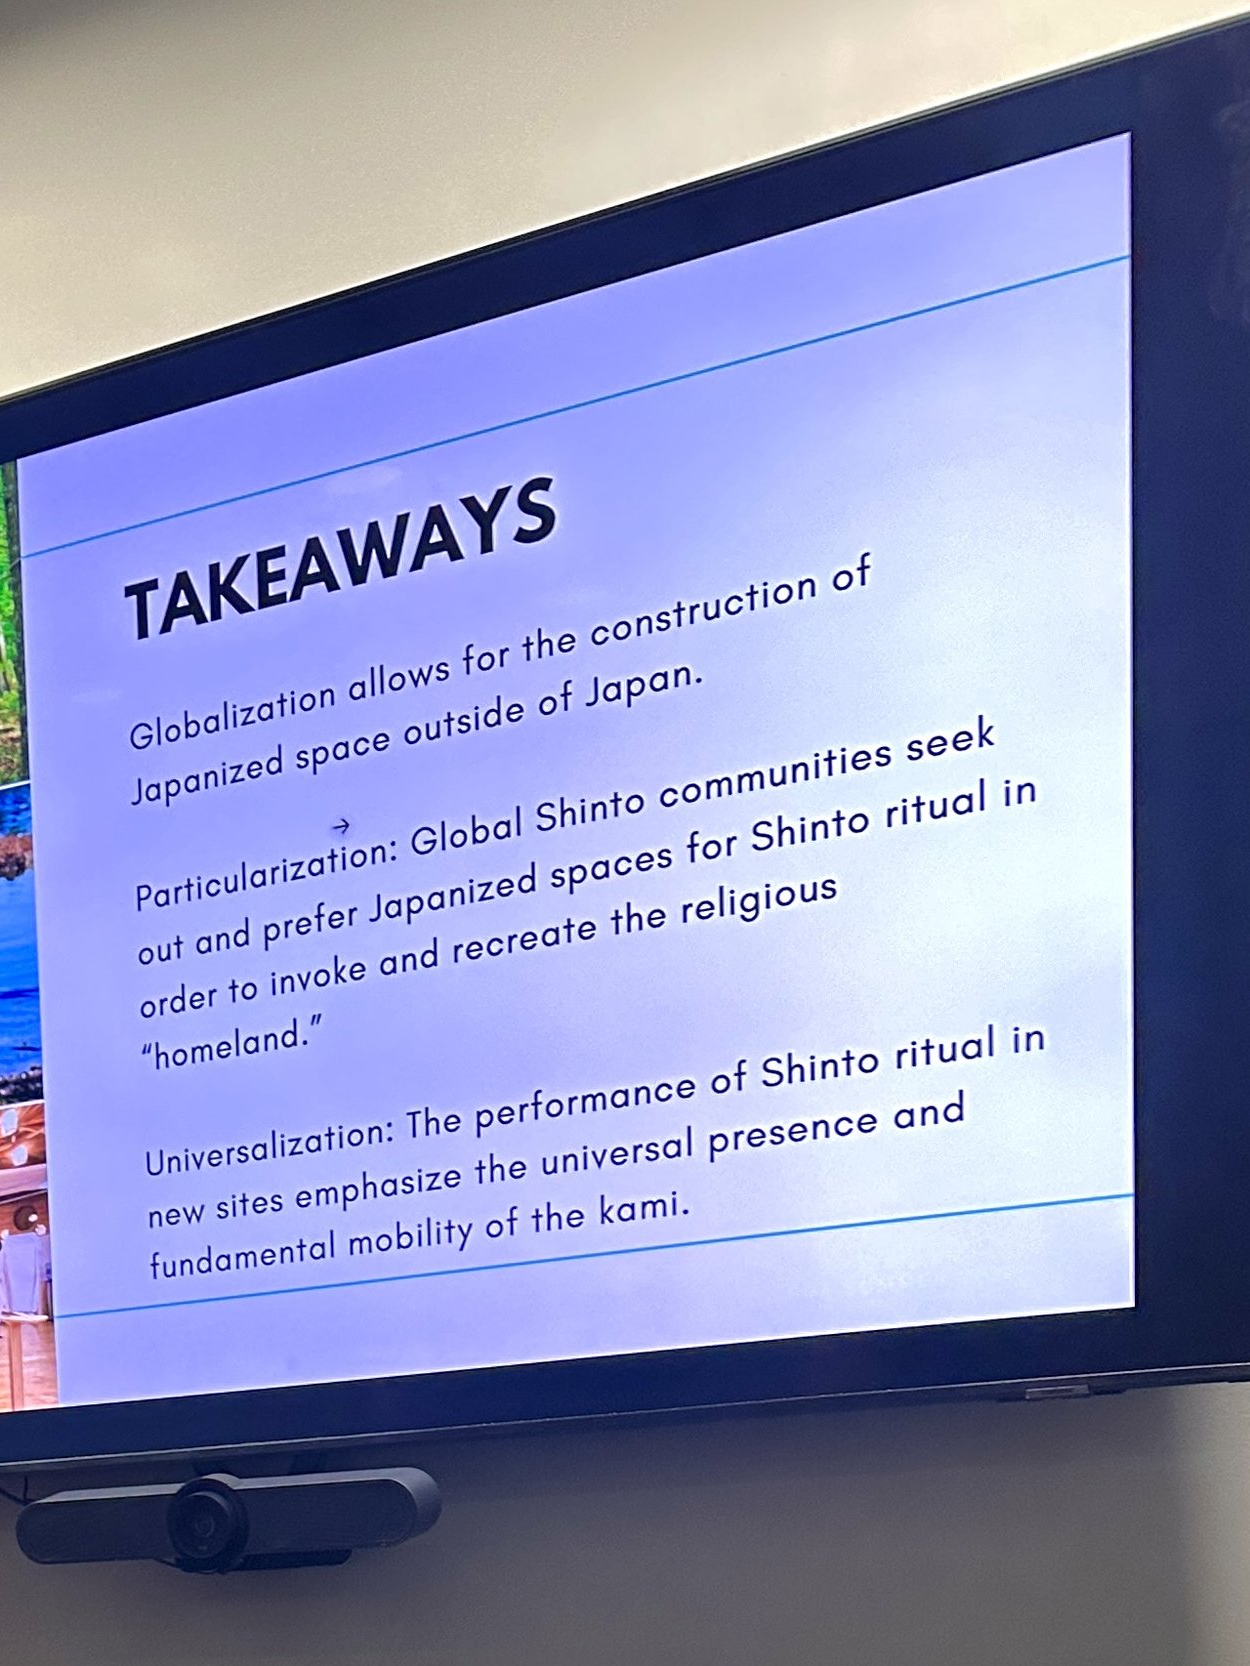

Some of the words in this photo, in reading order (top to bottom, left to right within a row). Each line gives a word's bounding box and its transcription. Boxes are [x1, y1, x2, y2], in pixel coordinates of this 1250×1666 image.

[124, 476, 556, 641] TAKEAWAYS
[129, 688, 335, 750] Globalization
[348, 661, 450, 701] allows
[462, 643, 510, 676] for
[521, 627, 577, 662] the
[590, 577, 816, 646] construction
[832, 551, 871, 592] of
[130, 743, 283, 808] Japanized
[296, 732, 390, 776] space
[403, 694, 525, 745] outside
[538, 679, 573, 716] of
[585, 666, 703, 709] Japan.
[136, 840, 397, 912] Particularization:
[411, 805, 522, 856] Global
[536, 791, 645, 832] Shinto
[659, 745, 892, 808] communities
[906, 714, 995, 762] seek
[138, 934, 184, 966] out
[195, 916, 250, 955] and
[263, 901, 358, 952] prefer
[368, 860, 536, 926] Japanized
[550, 848, 673, 896] spaces
[686, 830, 738, 864] for
[751, 809, 870, 852] Shinto
[886, 777, 986, 828] ritual
[1003, 779, 1036, 807] in
[139, 982, 218, 1019] order
[227, 978, 258, 1004] to
[270, 954, 367, 997] invoke
[379, 936, 438, 976] and
[453, 917, 597, 964] recreate
[609, 901, 667, 936] the
[682, 878, 838, 924] religious
[145, 1121, 394, 1177] Universalization:
[405, 1106, 462, 1139] The
[475, 1079, 696, 1139] performance
[710, 1058, 747, 1095] of
[761, 1049, 880, 1088] Shinto
[896, 1023, 995, 1070] ritual
[1012, 1026, 1045, 1054] in
[148, 1203, 206, 1229] new
[216, 1192, 284, 1220] sites
[295, 1168, 462, 1212] emphasize
[474, 1152, 527, 1185] the
[541, 1125, 693, 1176] universal
[709, 1113, 878, 1164] presence
[893, 1088, 965, 1130] and
[149, 1229, 335, 1280] fundamental
[349, 1216, 473, 1256] mobility
[485, 1205, 519, 1239] of
[530, 1201, 585, 1233] the
[600, 1190, 690, 1225] kami.
